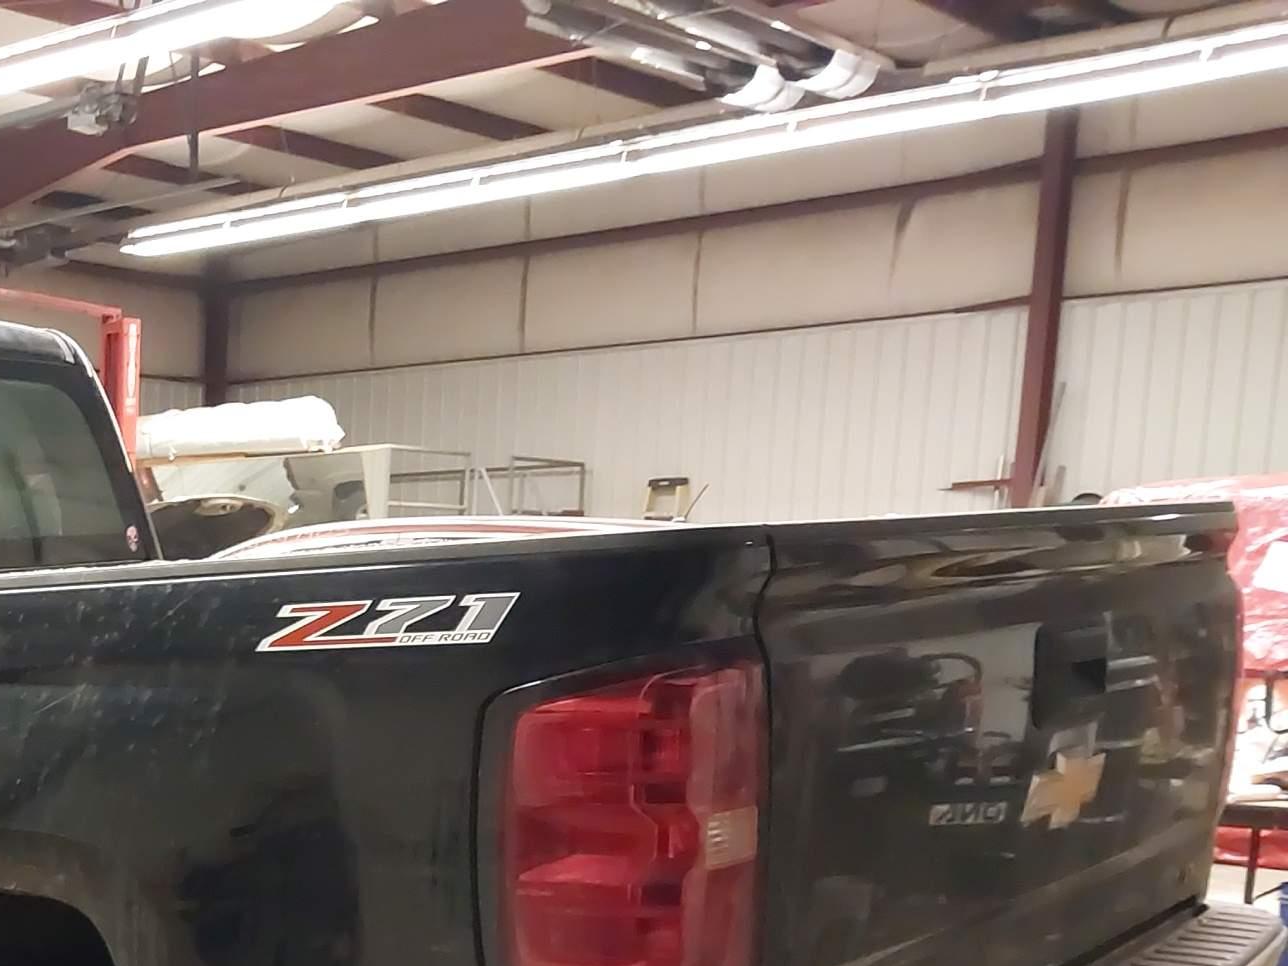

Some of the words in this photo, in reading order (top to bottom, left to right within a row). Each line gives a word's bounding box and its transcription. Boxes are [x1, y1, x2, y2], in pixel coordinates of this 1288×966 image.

[255, 592, 521, 652] Z71
[398, 632, 435, 645] OFF
[439, 631, 491, 643] ROAD
